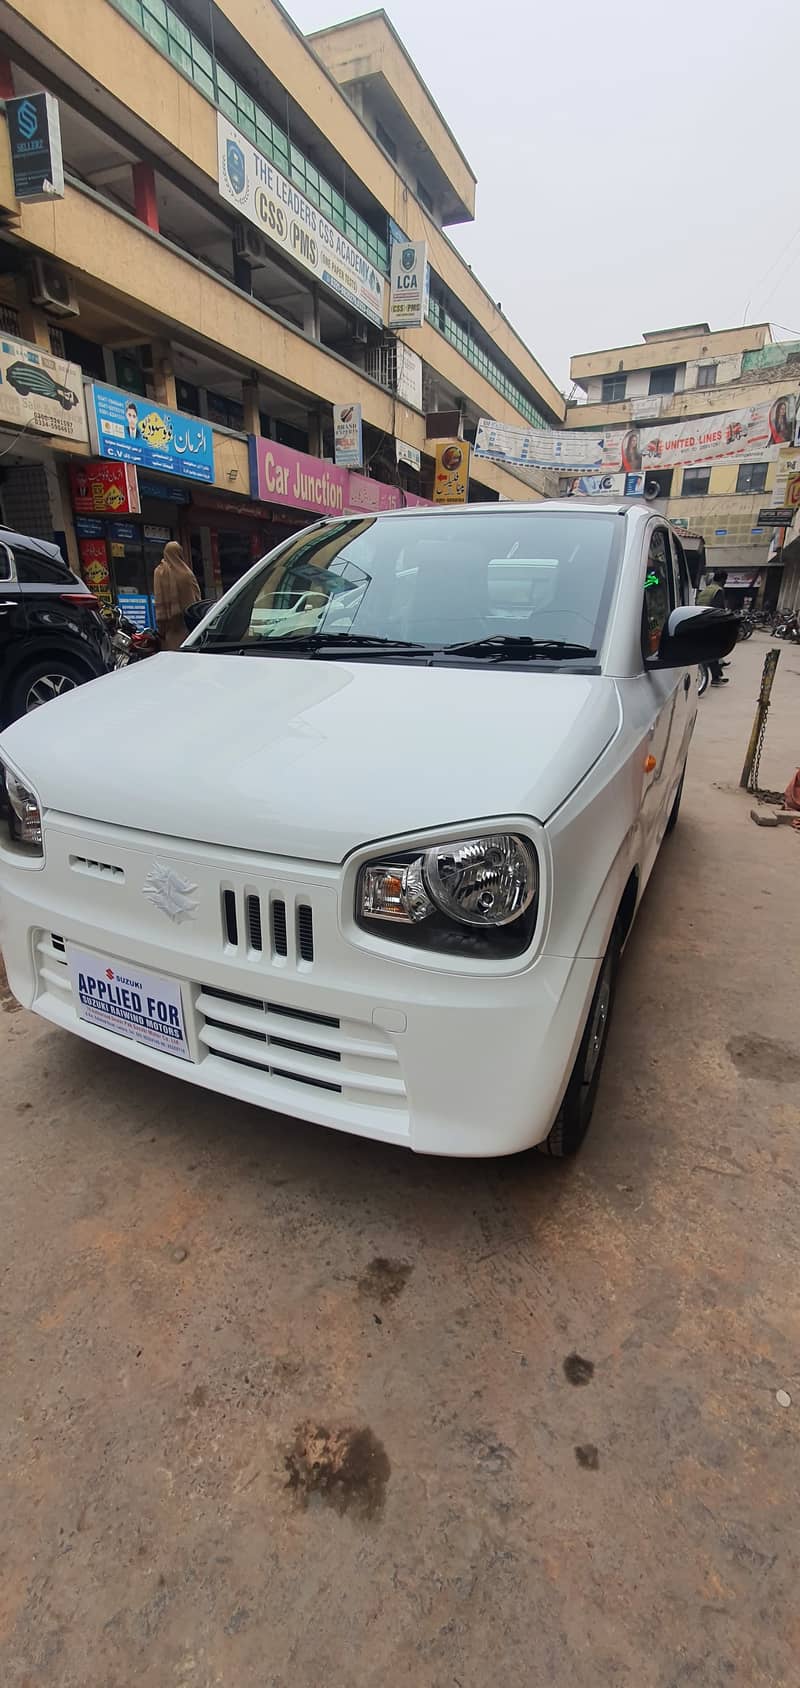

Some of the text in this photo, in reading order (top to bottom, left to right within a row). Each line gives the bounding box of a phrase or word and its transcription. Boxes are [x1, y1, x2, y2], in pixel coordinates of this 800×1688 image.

[253, 152, 369, 281] THE LEADERS CSS ACADEMY
[259, 192, 317, 265] CSS PMS
[397, 274, 418, 289] LCA
[665, 438, 695, 450] UNITED
[699, 431, 722, 443] LINES
[265, 452, 290, 496] Car
[293, 462, 343, 511] Junction
[78, 972, 180, 1028] APPLIED FOR
[116, 975, 143, 989] SUZUKI
[84, 995, 110, 1013] SUZUKI
[110, 1006, 145, 1026] RAIWIND
[146, 1017, 180, 1038] MOTORS
